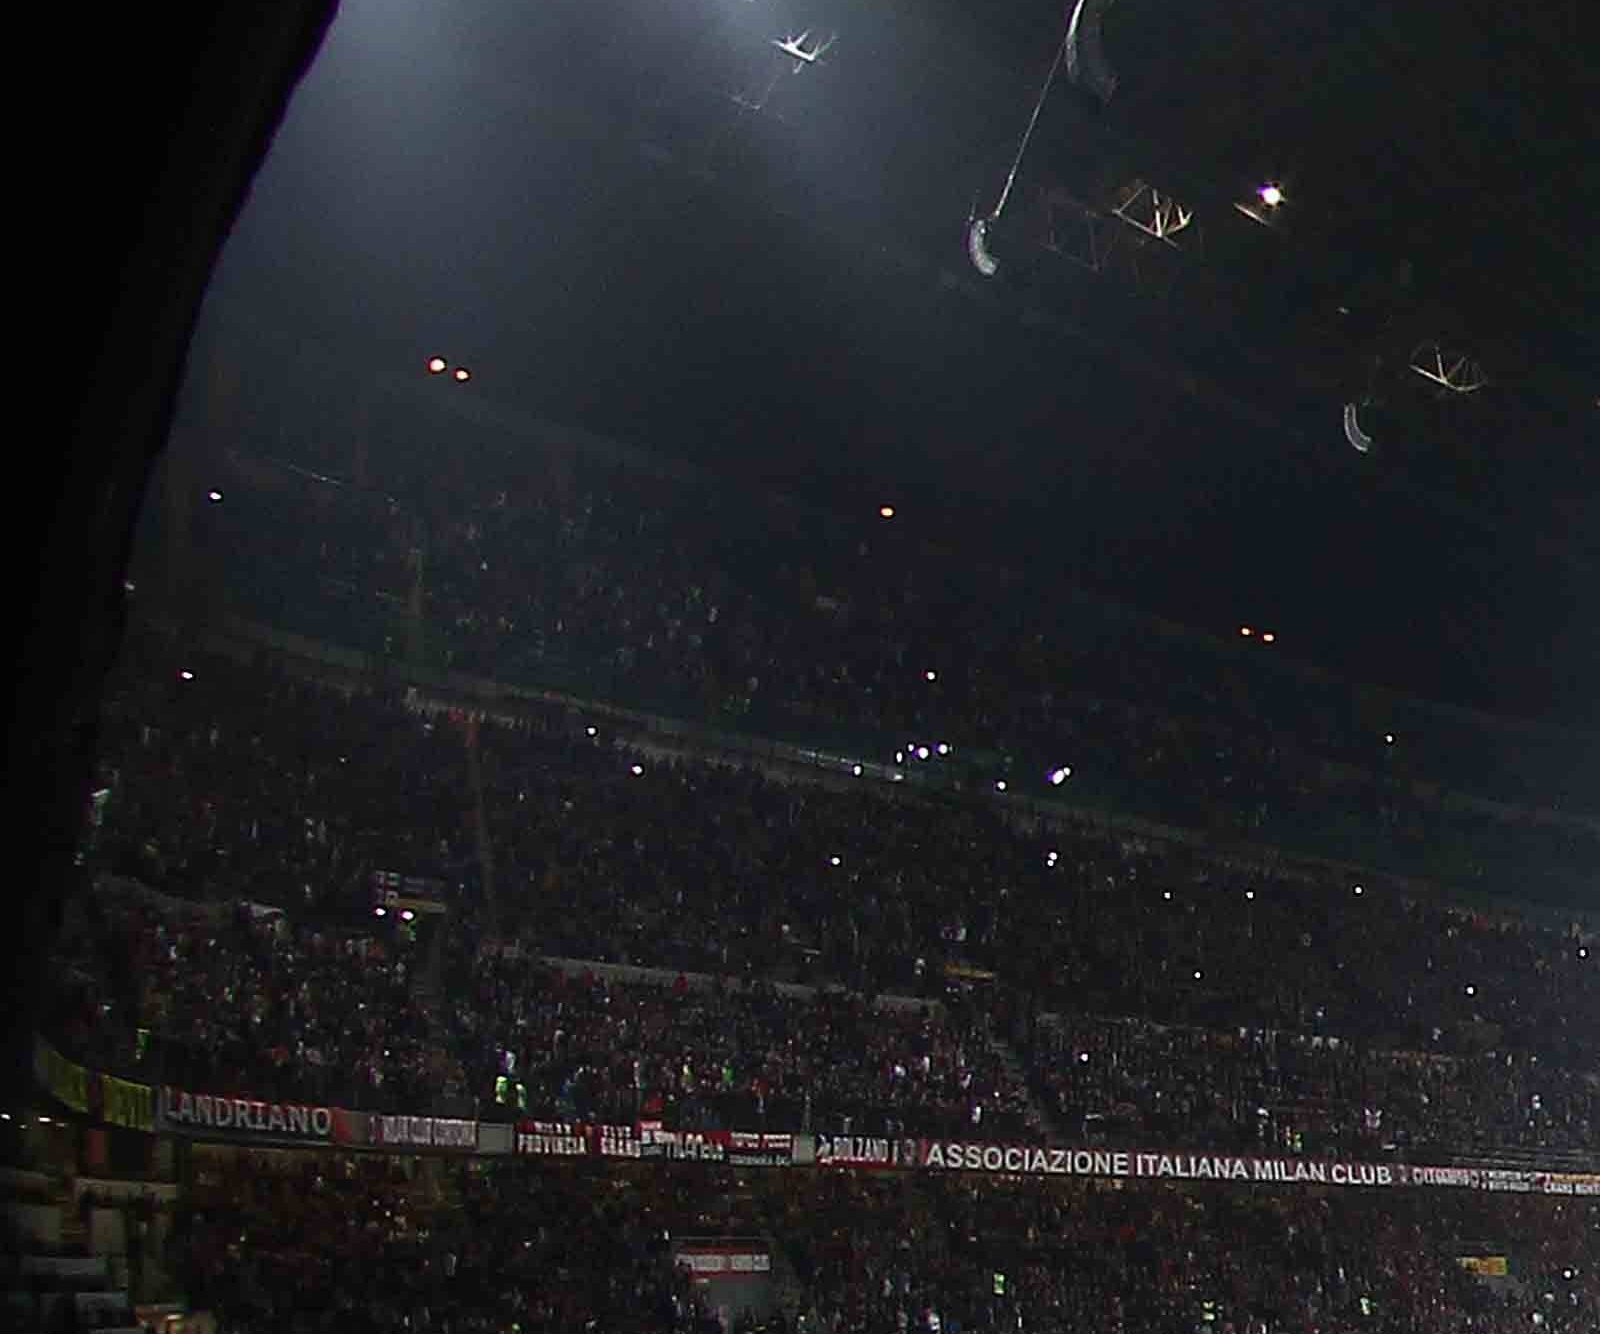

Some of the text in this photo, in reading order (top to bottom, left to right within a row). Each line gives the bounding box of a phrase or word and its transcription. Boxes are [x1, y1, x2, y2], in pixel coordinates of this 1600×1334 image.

[164, 1085, 332, 1134] LANDRIANO
[927, 1141, 1128, 1176] ASSOCIAZIONE
[1136, 1153, 1249, 1180] ITALIANA
[1254, 1157, 1326, 1183] MILAN
[1331, 1160, 1392, 1186] CLUB
